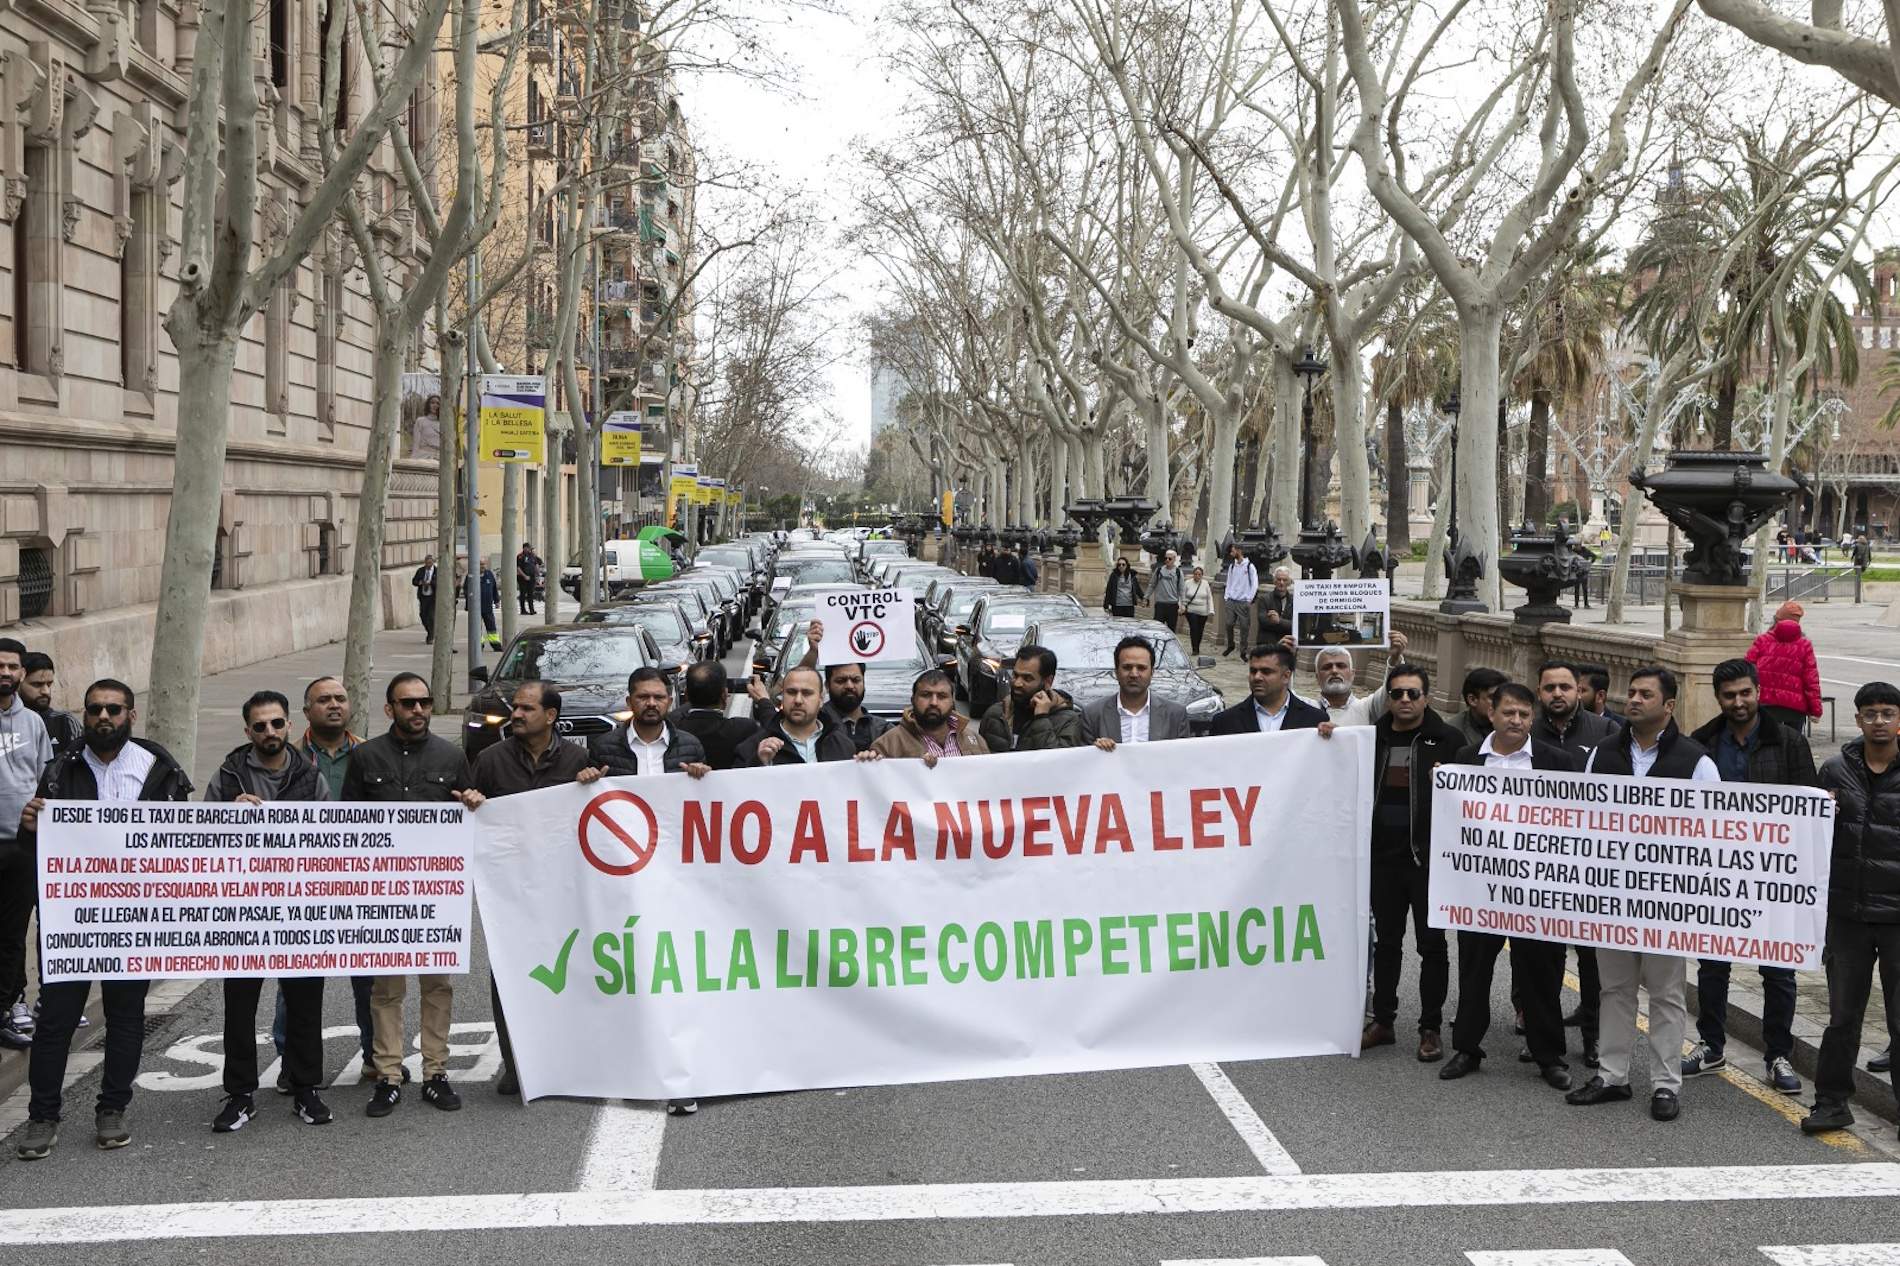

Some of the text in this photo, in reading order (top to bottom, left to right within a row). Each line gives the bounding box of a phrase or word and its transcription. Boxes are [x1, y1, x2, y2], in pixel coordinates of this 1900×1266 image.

[827, 592, 903, 606] CONTROL
[844, 604, 887, 621] VTC
[1435, 771, 1832, 817] SOMOS AUTÓNOMOS LIBRE DE TRANSPORTE
[52, 807, 463, 824] DESDE 1906 EL TAXI DE BARCELONA ROBA AL CIUDADANO Y SIGUEN CON
[682, 787, 1259, 863] NO A LA NUEVA LEY
[1462, 800, 1790, 844] NO AL DECRET LLEI CONTRA LES VTC
[126, 833, 394, 848] LOS ANTECEDENTES DE MALA PRAXIS EN 2025.
[1461, 827, 1797, 874] NO AL DECRETO LEY CONTRA LAS VTC
[47, 856, 464, 874] EN LA ZONA DE SALIDAS DE LA T1, CUATRO FURGONETAS ANTIDISTURBIOS
[46, 880, 464, 899] DE LOS MOSSOS D'ESQUADRA VELAN POR LA SEGURIDAD DE LOS TAXISTAS
[1442, 852, 1817, 905] “VOTAMOS PARA QUE DEFENDÁIS A TODOS
[74, 904, 436, 924] QUE LLEGAN A EL PRAT CON PASAJE, YA QUE UNA TREINTENA DE
[1487, 883, 1762, 928] Y NO DEFENDER MONOPOLIOS”
[46, 925, 462, 949] CONDUCTORES EN HUELGA ABRONCA A TODOS LOS VEHÍCULOS QUE ESTÁN
[1440, 905, 1815, 963] “NO SOMOS VIOLENTOS NI AMENAZAMOS”
[591, 904, 1326, 996] SÍ A LA LIBRE COMPETENCIA
[47, 952, 459, 975] CIRCULANDO. ES UN DERECHO NO UNA OBLIGACIÓN O DICTADURA DE TITO.
